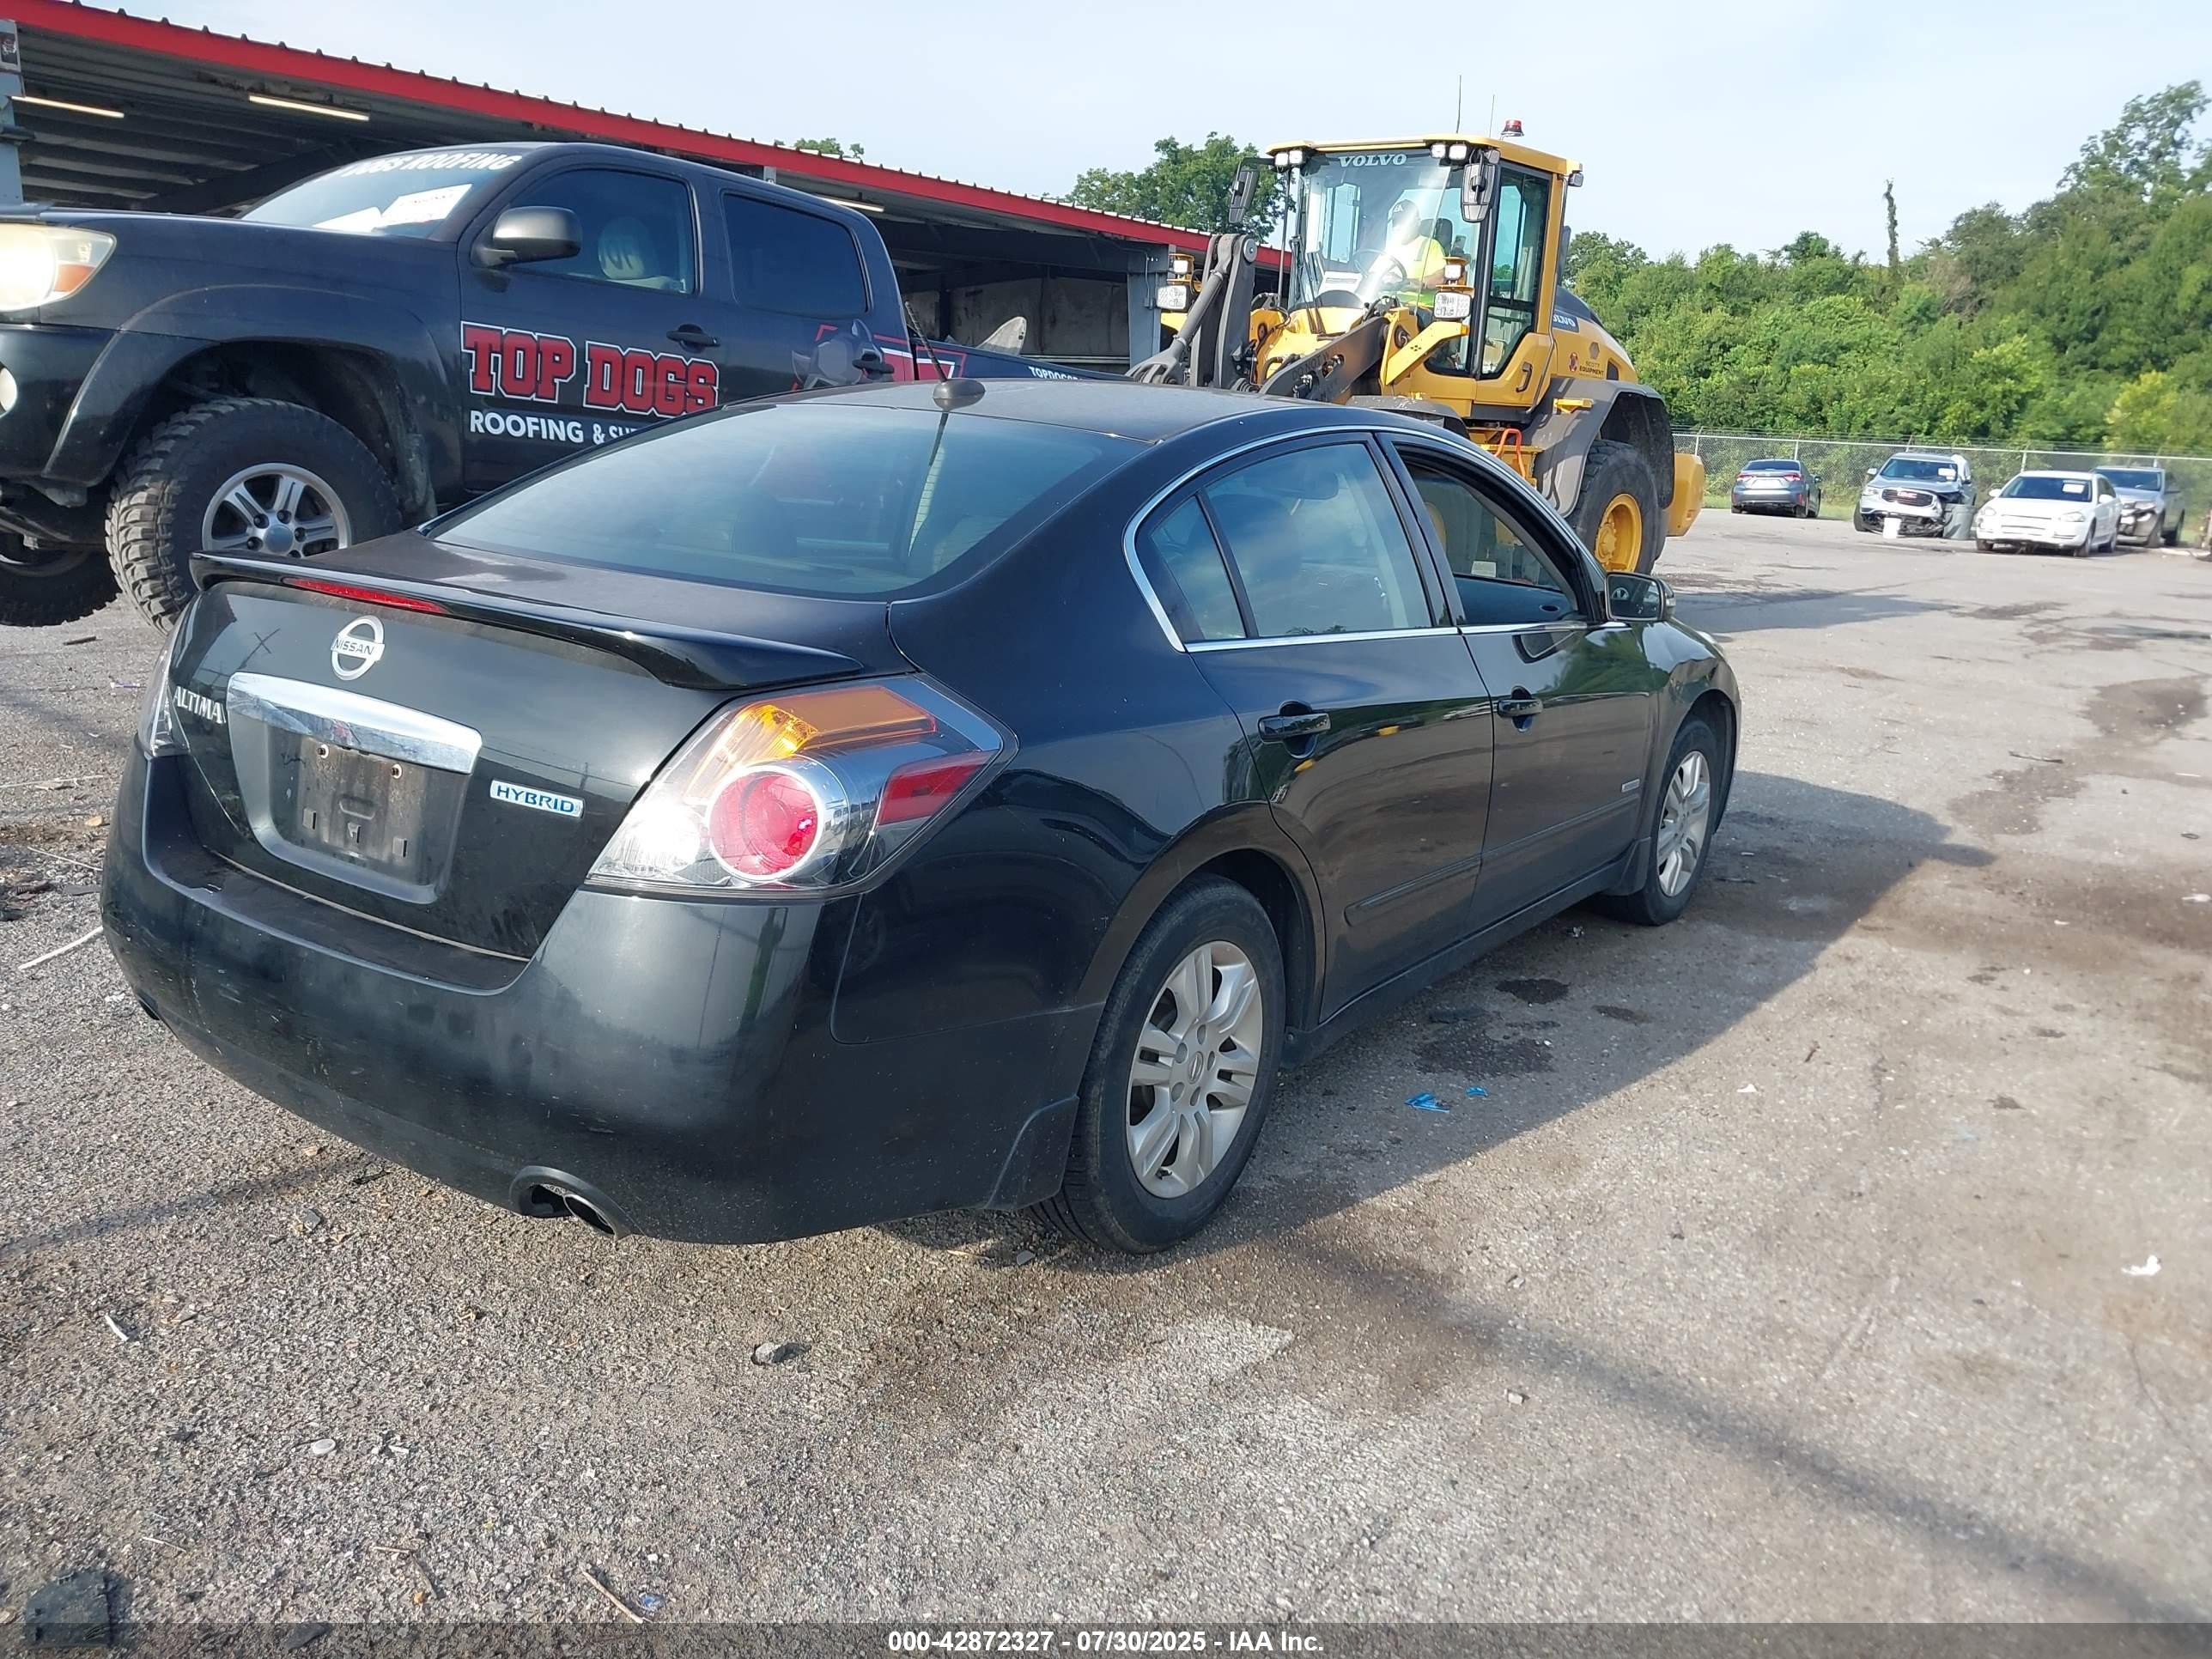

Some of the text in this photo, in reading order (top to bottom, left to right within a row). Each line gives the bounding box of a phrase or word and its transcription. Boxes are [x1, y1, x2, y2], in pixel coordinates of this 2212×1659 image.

[400, 153, 523, 170] ROOFING
[1339, 154, 1407, 167] VOLVO
[460, 321, 720, 418] TOP DOGS
[1579, 365, 1604, 376] EQUIPMENT
[470, 410, 585, 444] ROOFING
[592, 423, 605, 445] &
[333, 638, 375, 655] NISSAN
[173, 686, 227, 724] ALTIMA
[496, 785, 574, 812] HYBRID
